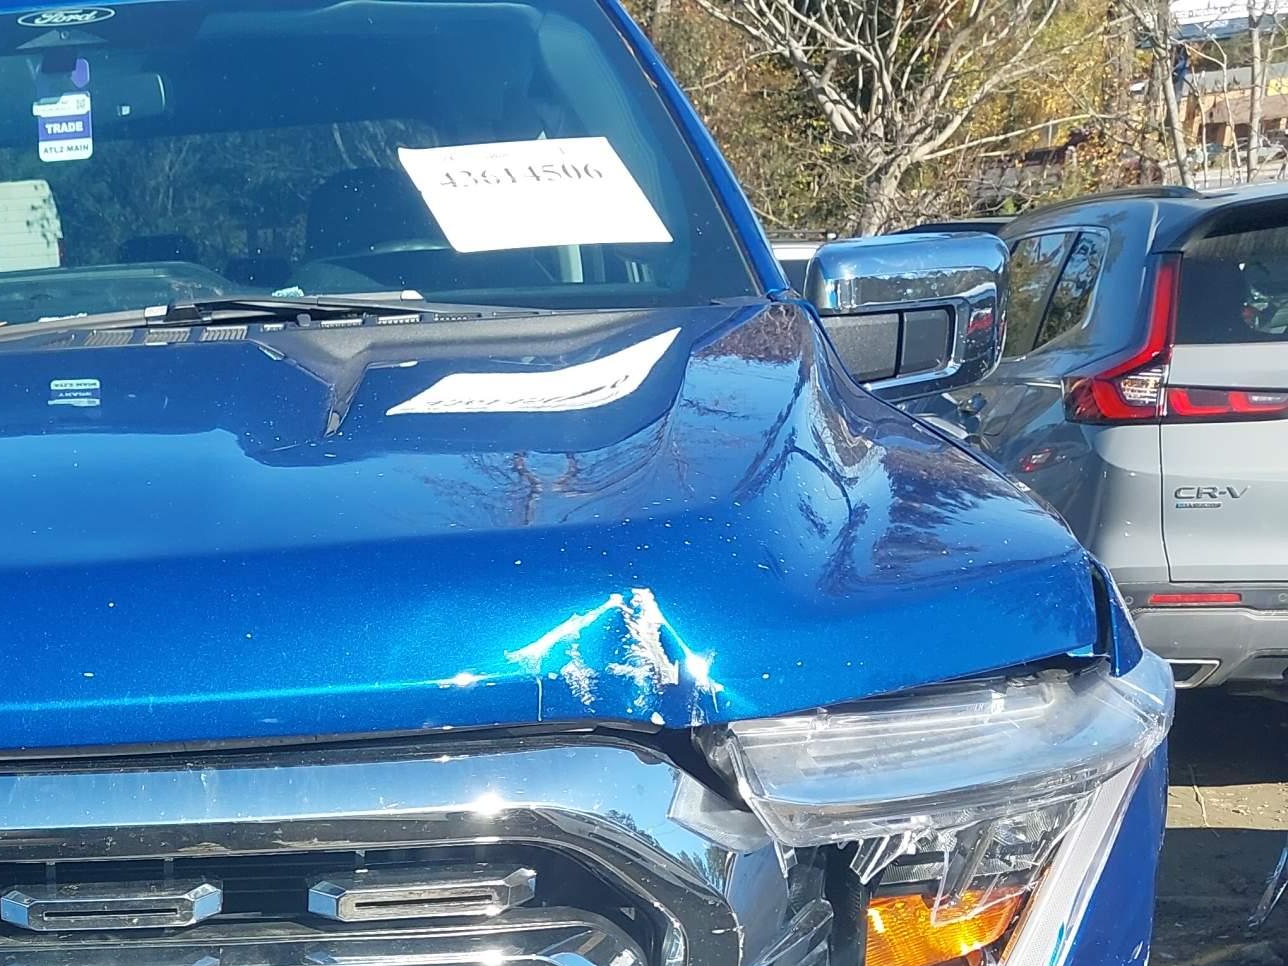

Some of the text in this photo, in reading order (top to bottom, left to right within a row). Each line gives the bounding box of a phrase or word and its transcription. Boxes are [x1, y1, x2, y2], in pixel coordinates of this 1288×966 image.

[34, 9, 98, 24] Ford
[45, 121, 84, 135] TRADE
[66, 144, 89, 153] MAIN
[1174, 486, 1249, 499] CR-V
